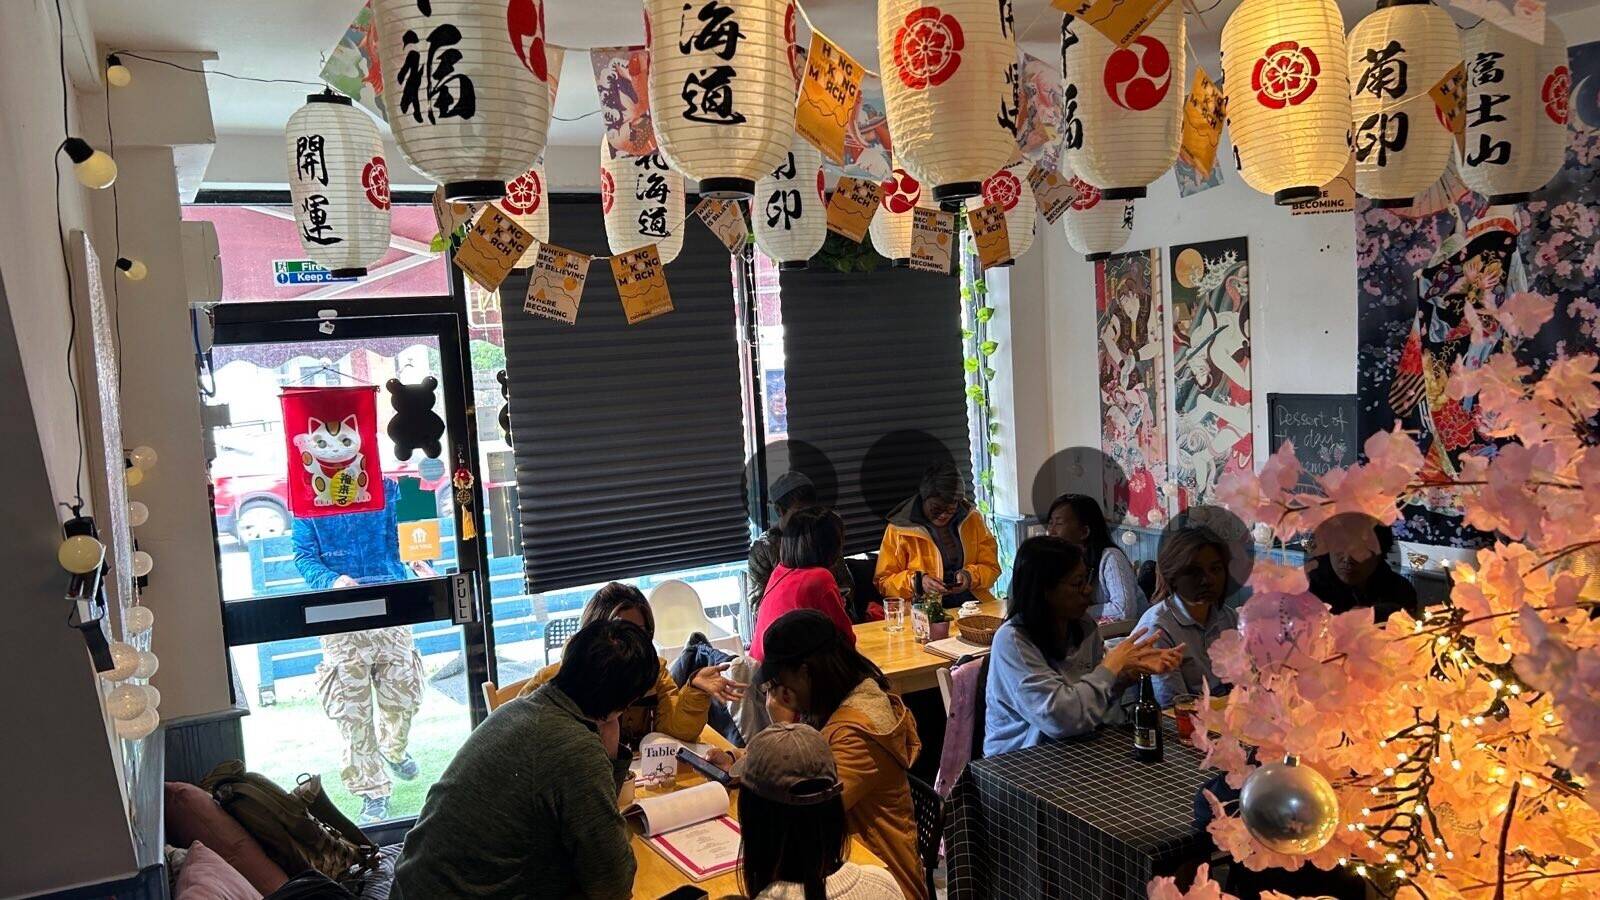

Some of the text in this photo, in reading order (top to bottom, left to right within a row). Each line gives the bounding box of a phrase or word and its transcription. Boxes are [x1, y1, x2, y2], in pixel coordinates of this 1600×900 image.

[397, 0, 477, 126] 福
[1466, 52, 1512, 167] 富士山
[296, 134, 344, 245] 開運
[1292, 199, 1345, 210] BECOMING
[920, 224, 953, 235] BELIEVING
[545, 264, 585, 280] BELIEVING
[911, 260, 943, 269] BECOMING
[297, 273, 323, 283] Keep
[526, 302, 567, 318] BECOMING
[1275, 404, 1348, 433] Dessert of
[457, 578, 467, 619] PULL
[645, 746, 676, 758] Table
[656, 762, 663, 773] 4
